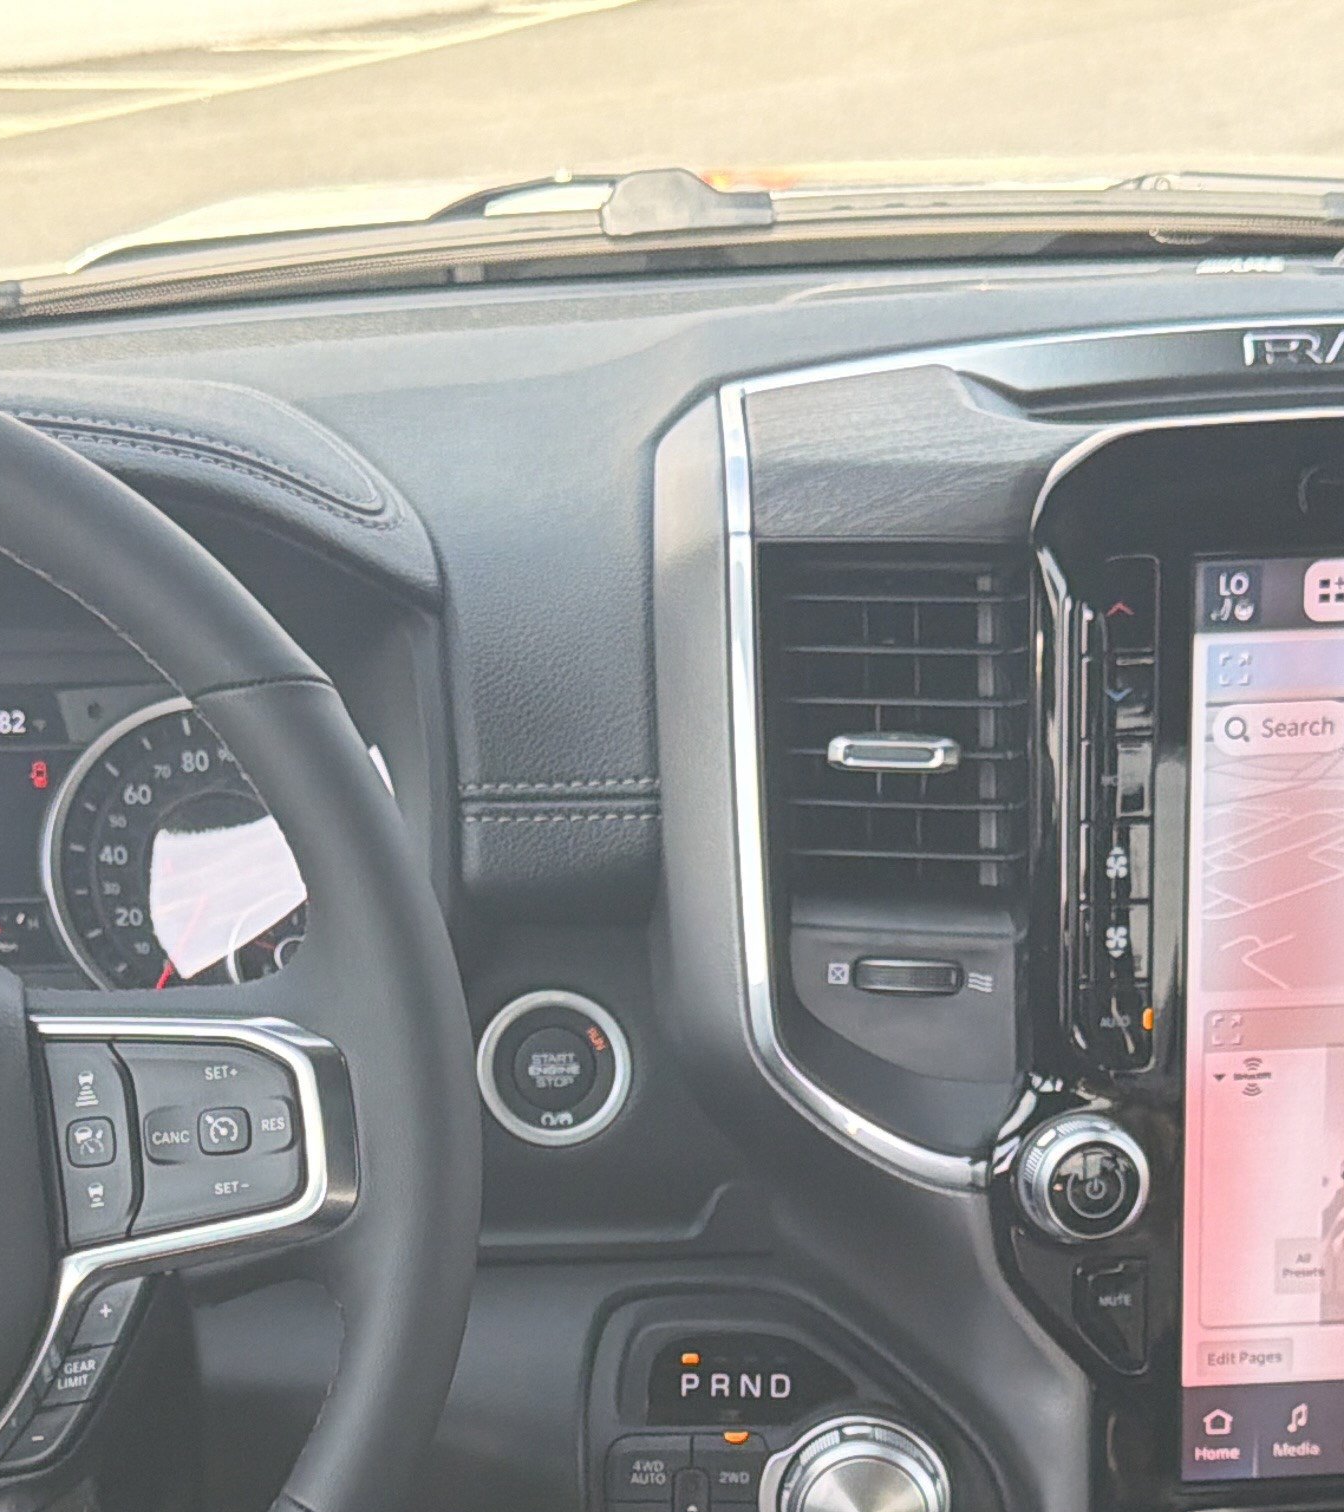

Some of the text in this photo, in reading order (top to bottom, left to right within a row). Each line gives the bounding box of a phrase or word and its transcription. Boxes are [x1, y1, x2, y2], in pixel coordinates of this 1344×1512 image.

[1219, 571, 1250, 596] LO
[1261, 716, 1335, 739] Search
[181, 750, 209, 772] 80
[154, 765, 172, 779] 70
[124, 784, 152, 804] 60
[99, 846, 128, 865] 40
[114, 907, 144, 927] 20
[531, 1052, 575, 1065] START
[535, 1076, 574, 1088] STOP
[261, 1117, 286, 1133] RES
[152, 1129, 190, 1145] CANC
[1098, 1293, 1132, 1308] MUTE
[64, 1358, 96, 1376] GEAR
[1207, 1350, 1283, 1368] Edit Pages
[57, 1374, 89, 1390] LIMIT
[1194, 1447, 1241, 1461] Home
[1273, 1441, 1321, 1458] Media
[632, 1460, 664, 1472] 4WD
[630, 1472, 666, 1485] AUTO
[718, 1471, 750, 1484] 2WD
